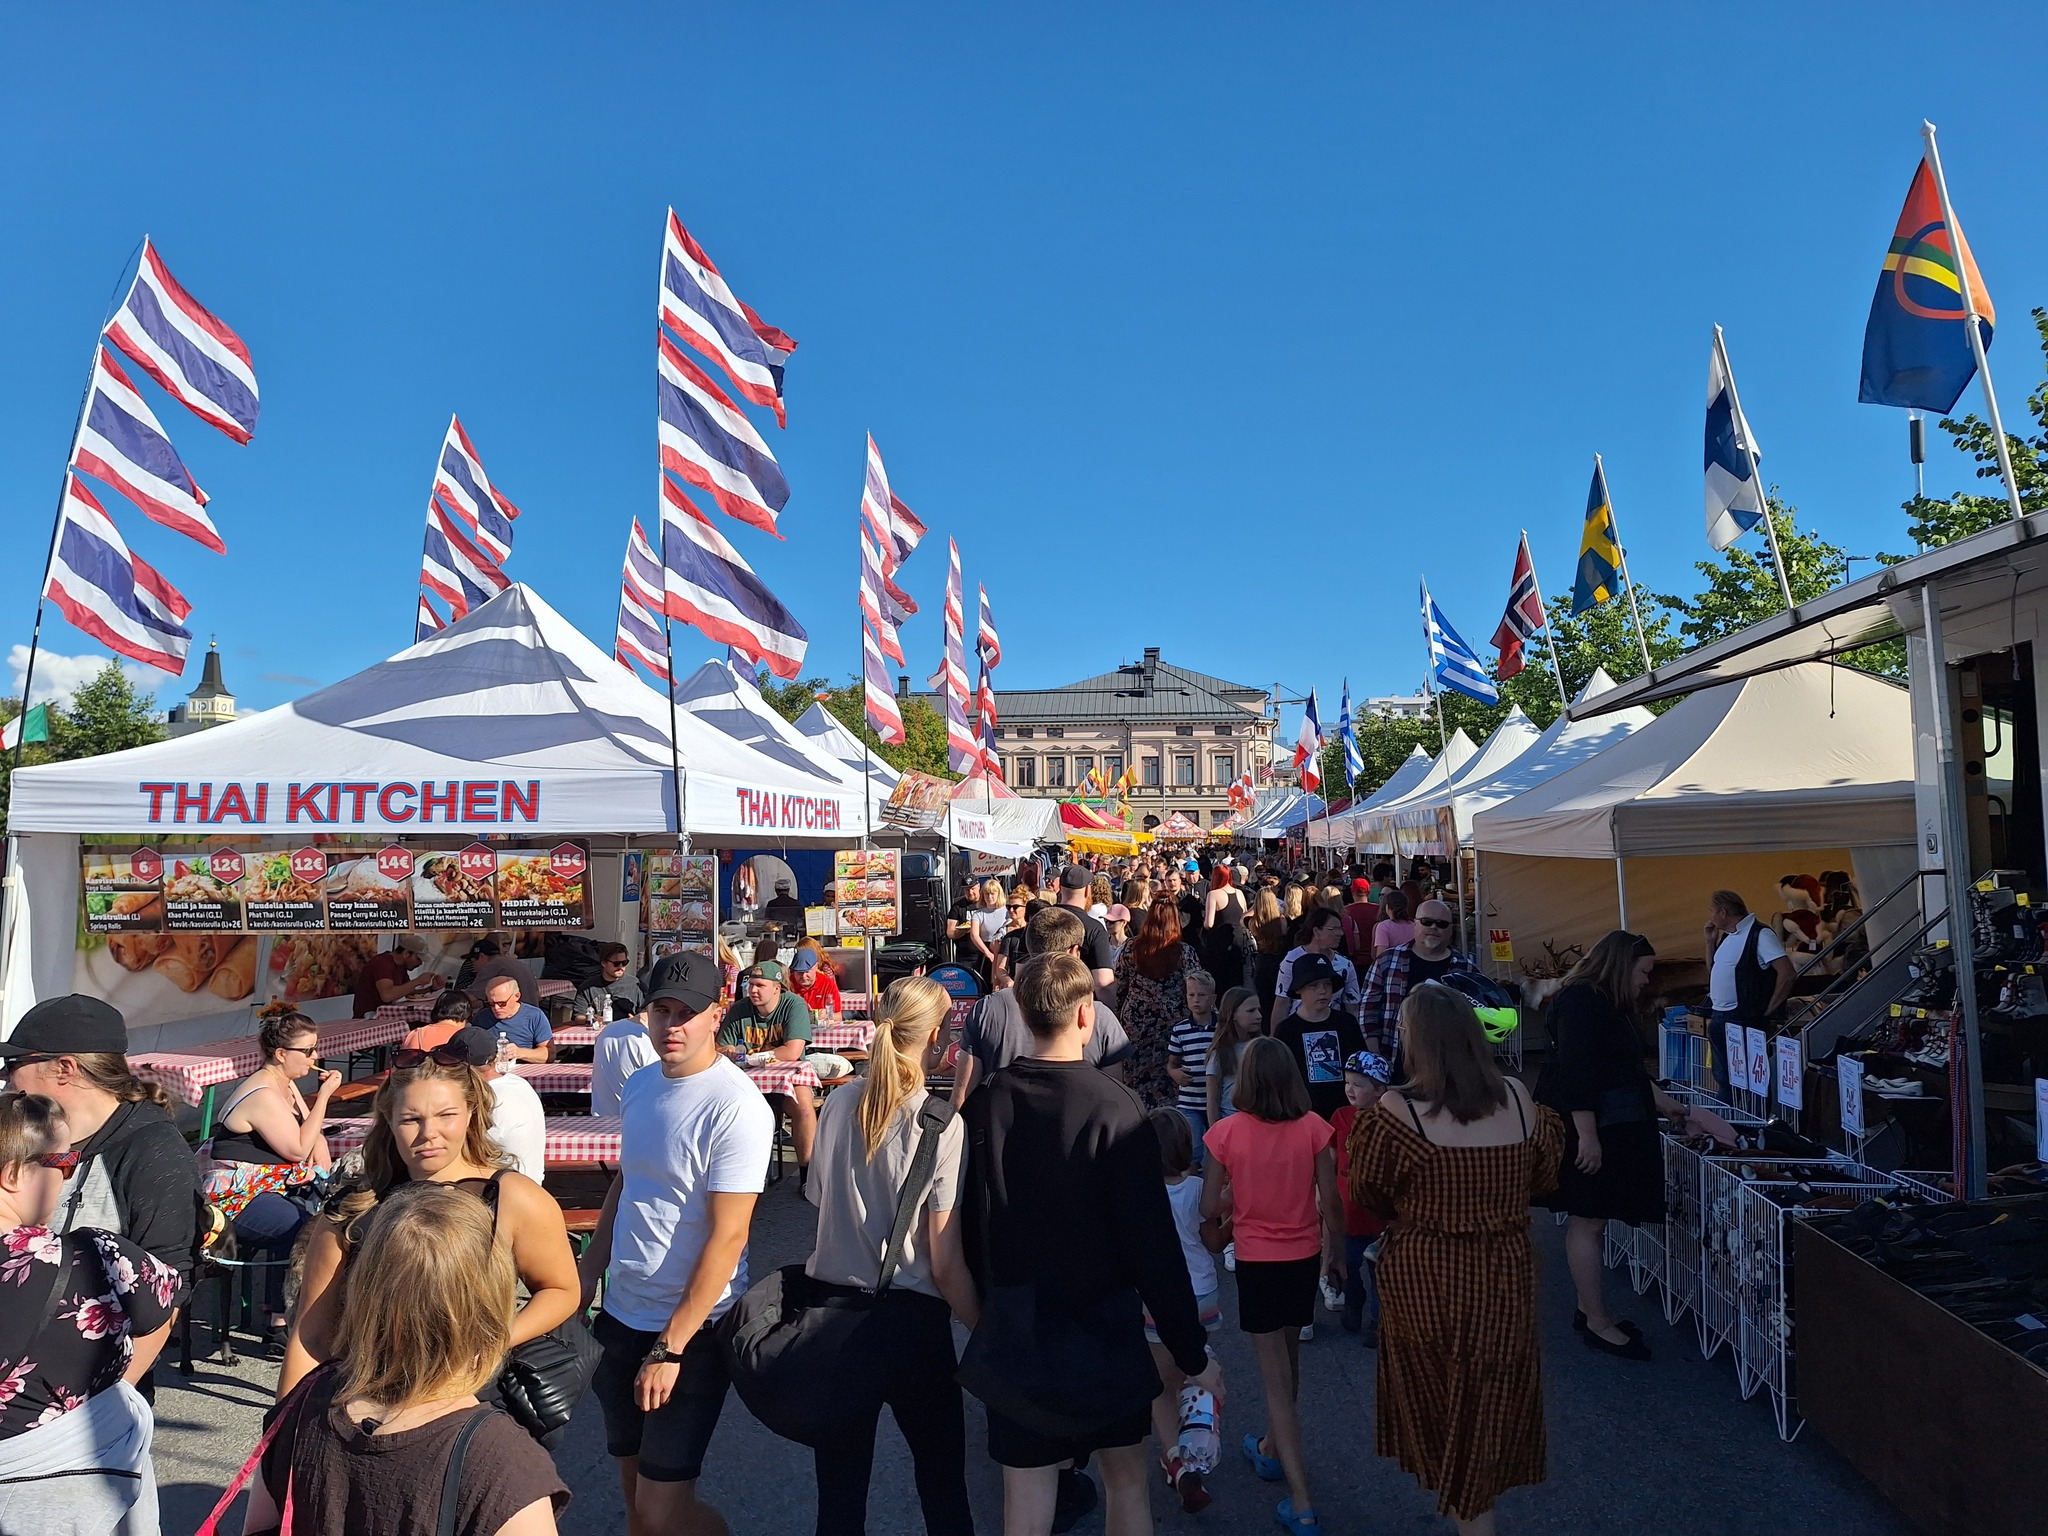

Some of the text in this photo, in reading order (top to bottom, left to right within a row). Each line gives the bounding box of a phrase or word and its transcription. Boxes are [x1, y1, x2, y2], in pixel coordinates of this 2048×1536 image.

[139, 780, 540, 823] THAI KITCHEN
[736, 787, 777, 826] THAI
[781, 794, 841, 830] KITCHEN
[293, 857, 323, 871] 12€
[379, 855, 410, 869] 14€
[461, 854, 492, 868] 14€
[552, 853, 582, 867] 15€
[212, 858, 241, 872] 12€
[973, 864, 1012, 873] MUKAAN
[189, 902, 198, 911] ja
[198, 902, 222, 910] kanaa
[329, 902, 353, 910] Curry
[546, 899, 565, 907] MIX
[167, 911, 182, 919] Khao
[182, 911, 196, 919] Phat
[196, 911, 205, 919] Kai
[330, 911, 352, 920] Panang
[352, 911, 369, 920] Curry
[501, 908, 569, 917] Kaksi ruokalajia (G,L)
[469, 919, 484, 927] +2€
[567, 917, 582, 925] +2€
[90, 922, 122, 930] Spring Rolls
[1490, 929, 1510, 943] ALE
[666, 961, 691, 983] NY
